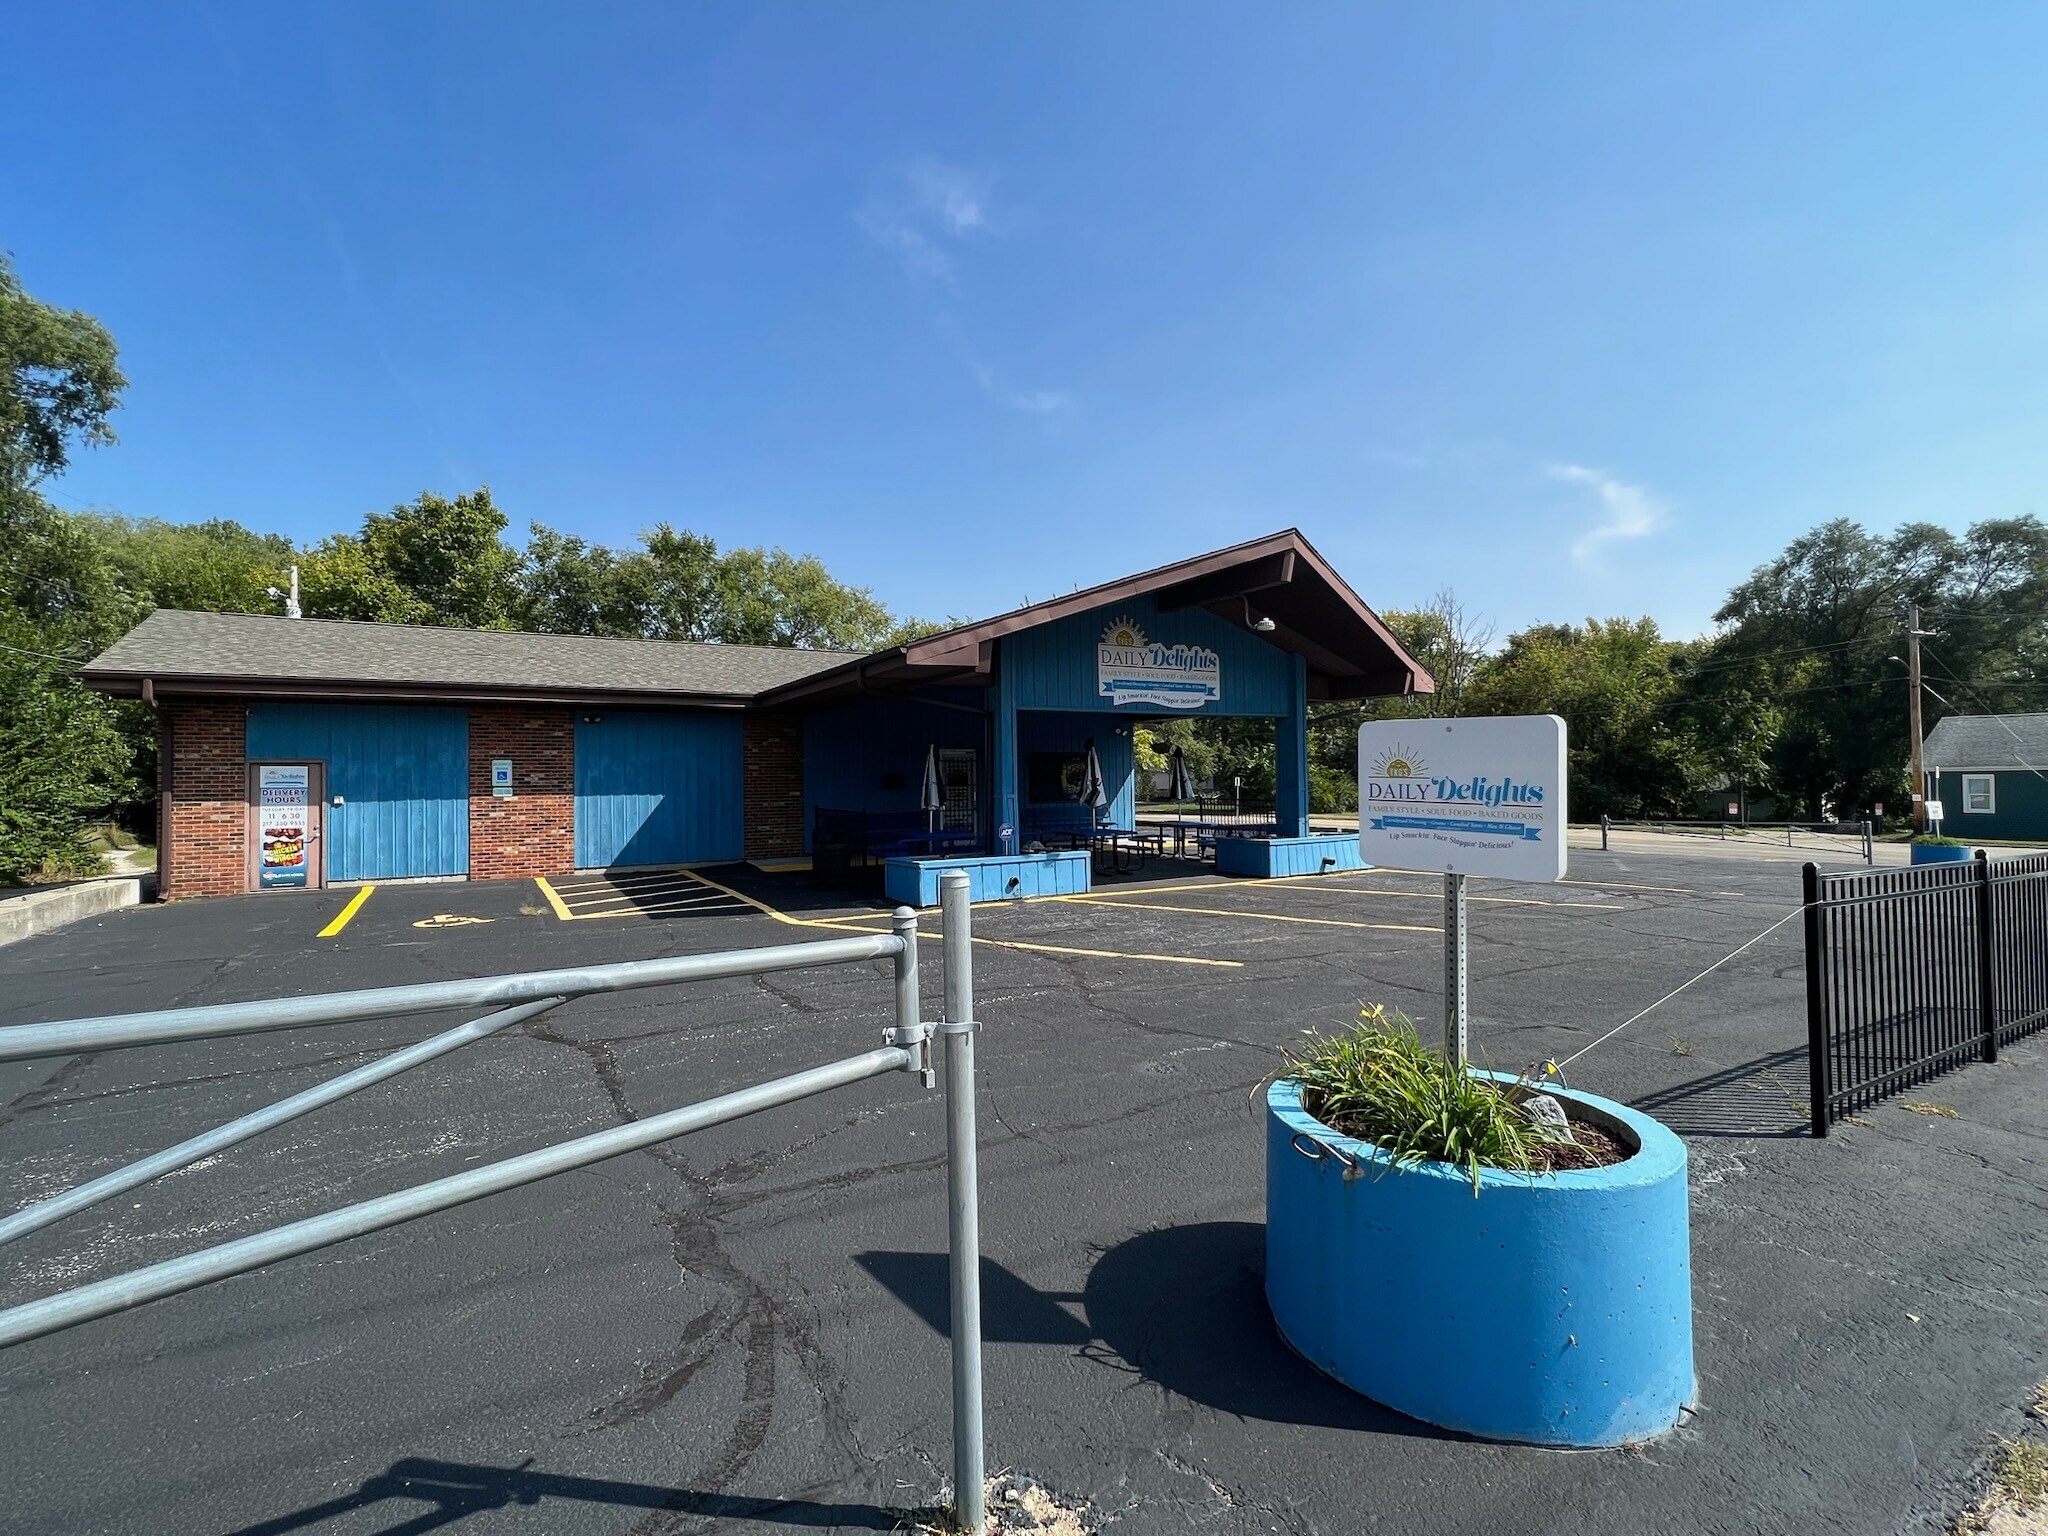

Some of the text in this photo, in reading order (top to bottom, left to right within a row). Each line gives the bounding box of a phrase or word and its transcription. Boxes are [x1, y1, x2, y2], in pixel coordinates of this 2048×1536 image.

[1101, 646, 1217, 672] DAILY Delights
[1368, 776, 1543, 807] DAILY Delights
[1396, 806, 1419, 814] STYLE
[1479, 810, 1509, 818] BAKED
[1511, 812, 1543, 820] GOODS
[1433, 833, 1447, 841] Face
[1479, 840, 1514, 849] Delicious!
[268, 844, 298, 855] CHICKEN
